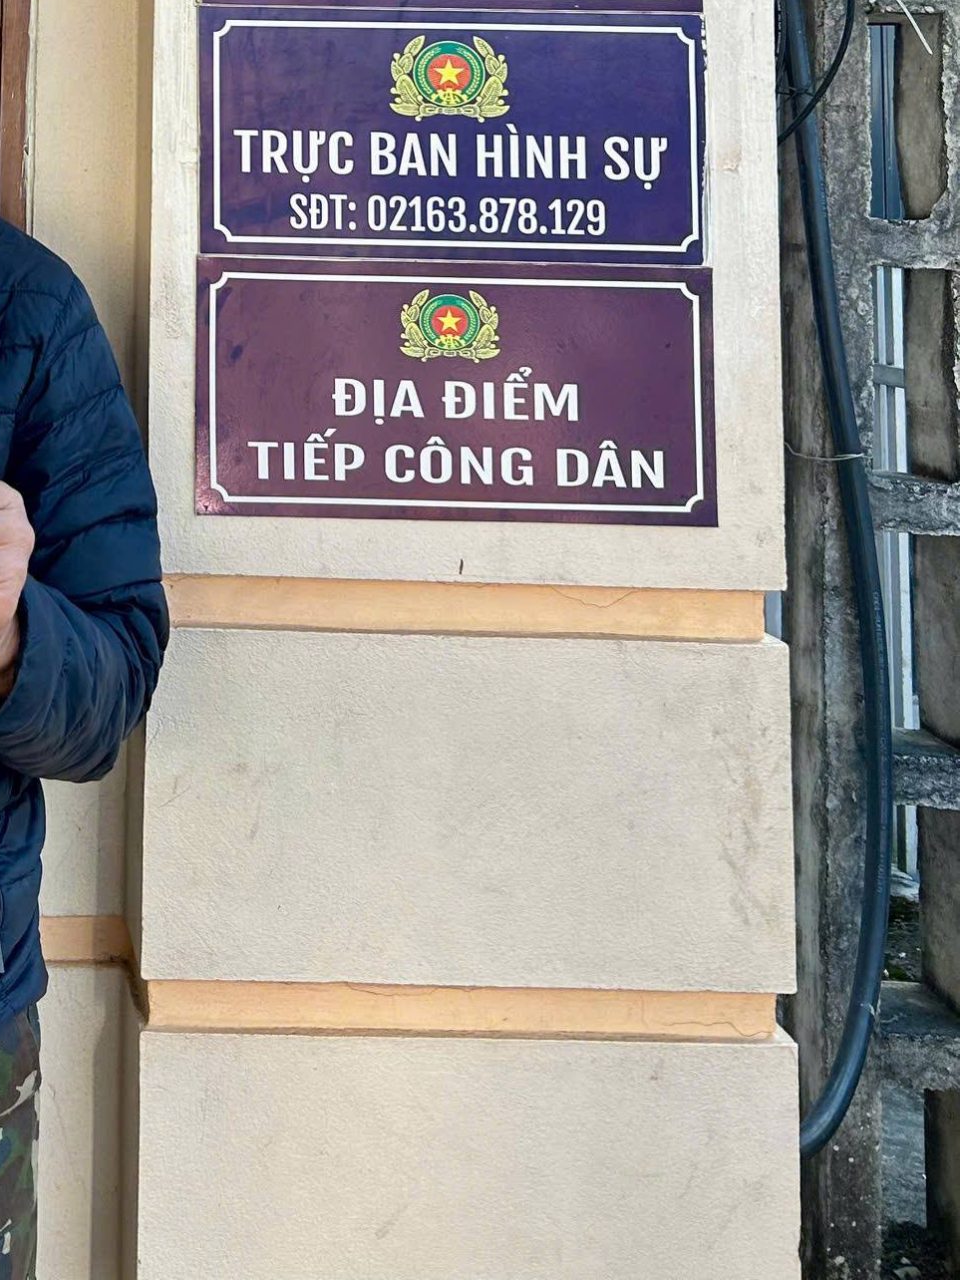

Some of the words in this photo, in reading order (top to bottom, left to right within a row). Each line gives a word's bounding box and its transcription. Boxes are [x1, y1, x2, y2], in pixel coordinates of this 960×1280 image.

[233, 128, 354, 183] TRỰC
[369, 131, 456, 177] BAN
[476, 123, 587, 180] HÌNH
[603, 136, 668, 190] SỰ
[289, 192, 357, 231] SĐT:
[367, 194, 606, 236] 02163.878.129
[331, 377, 425, 425] ĐỊA
[441, 366, 579, 423] ĐIỂM
[248, 428, 365, 482] TIẾP
[384, 436, 534, 487] CÔNG
[556, 439, 666, 489] DÂN
